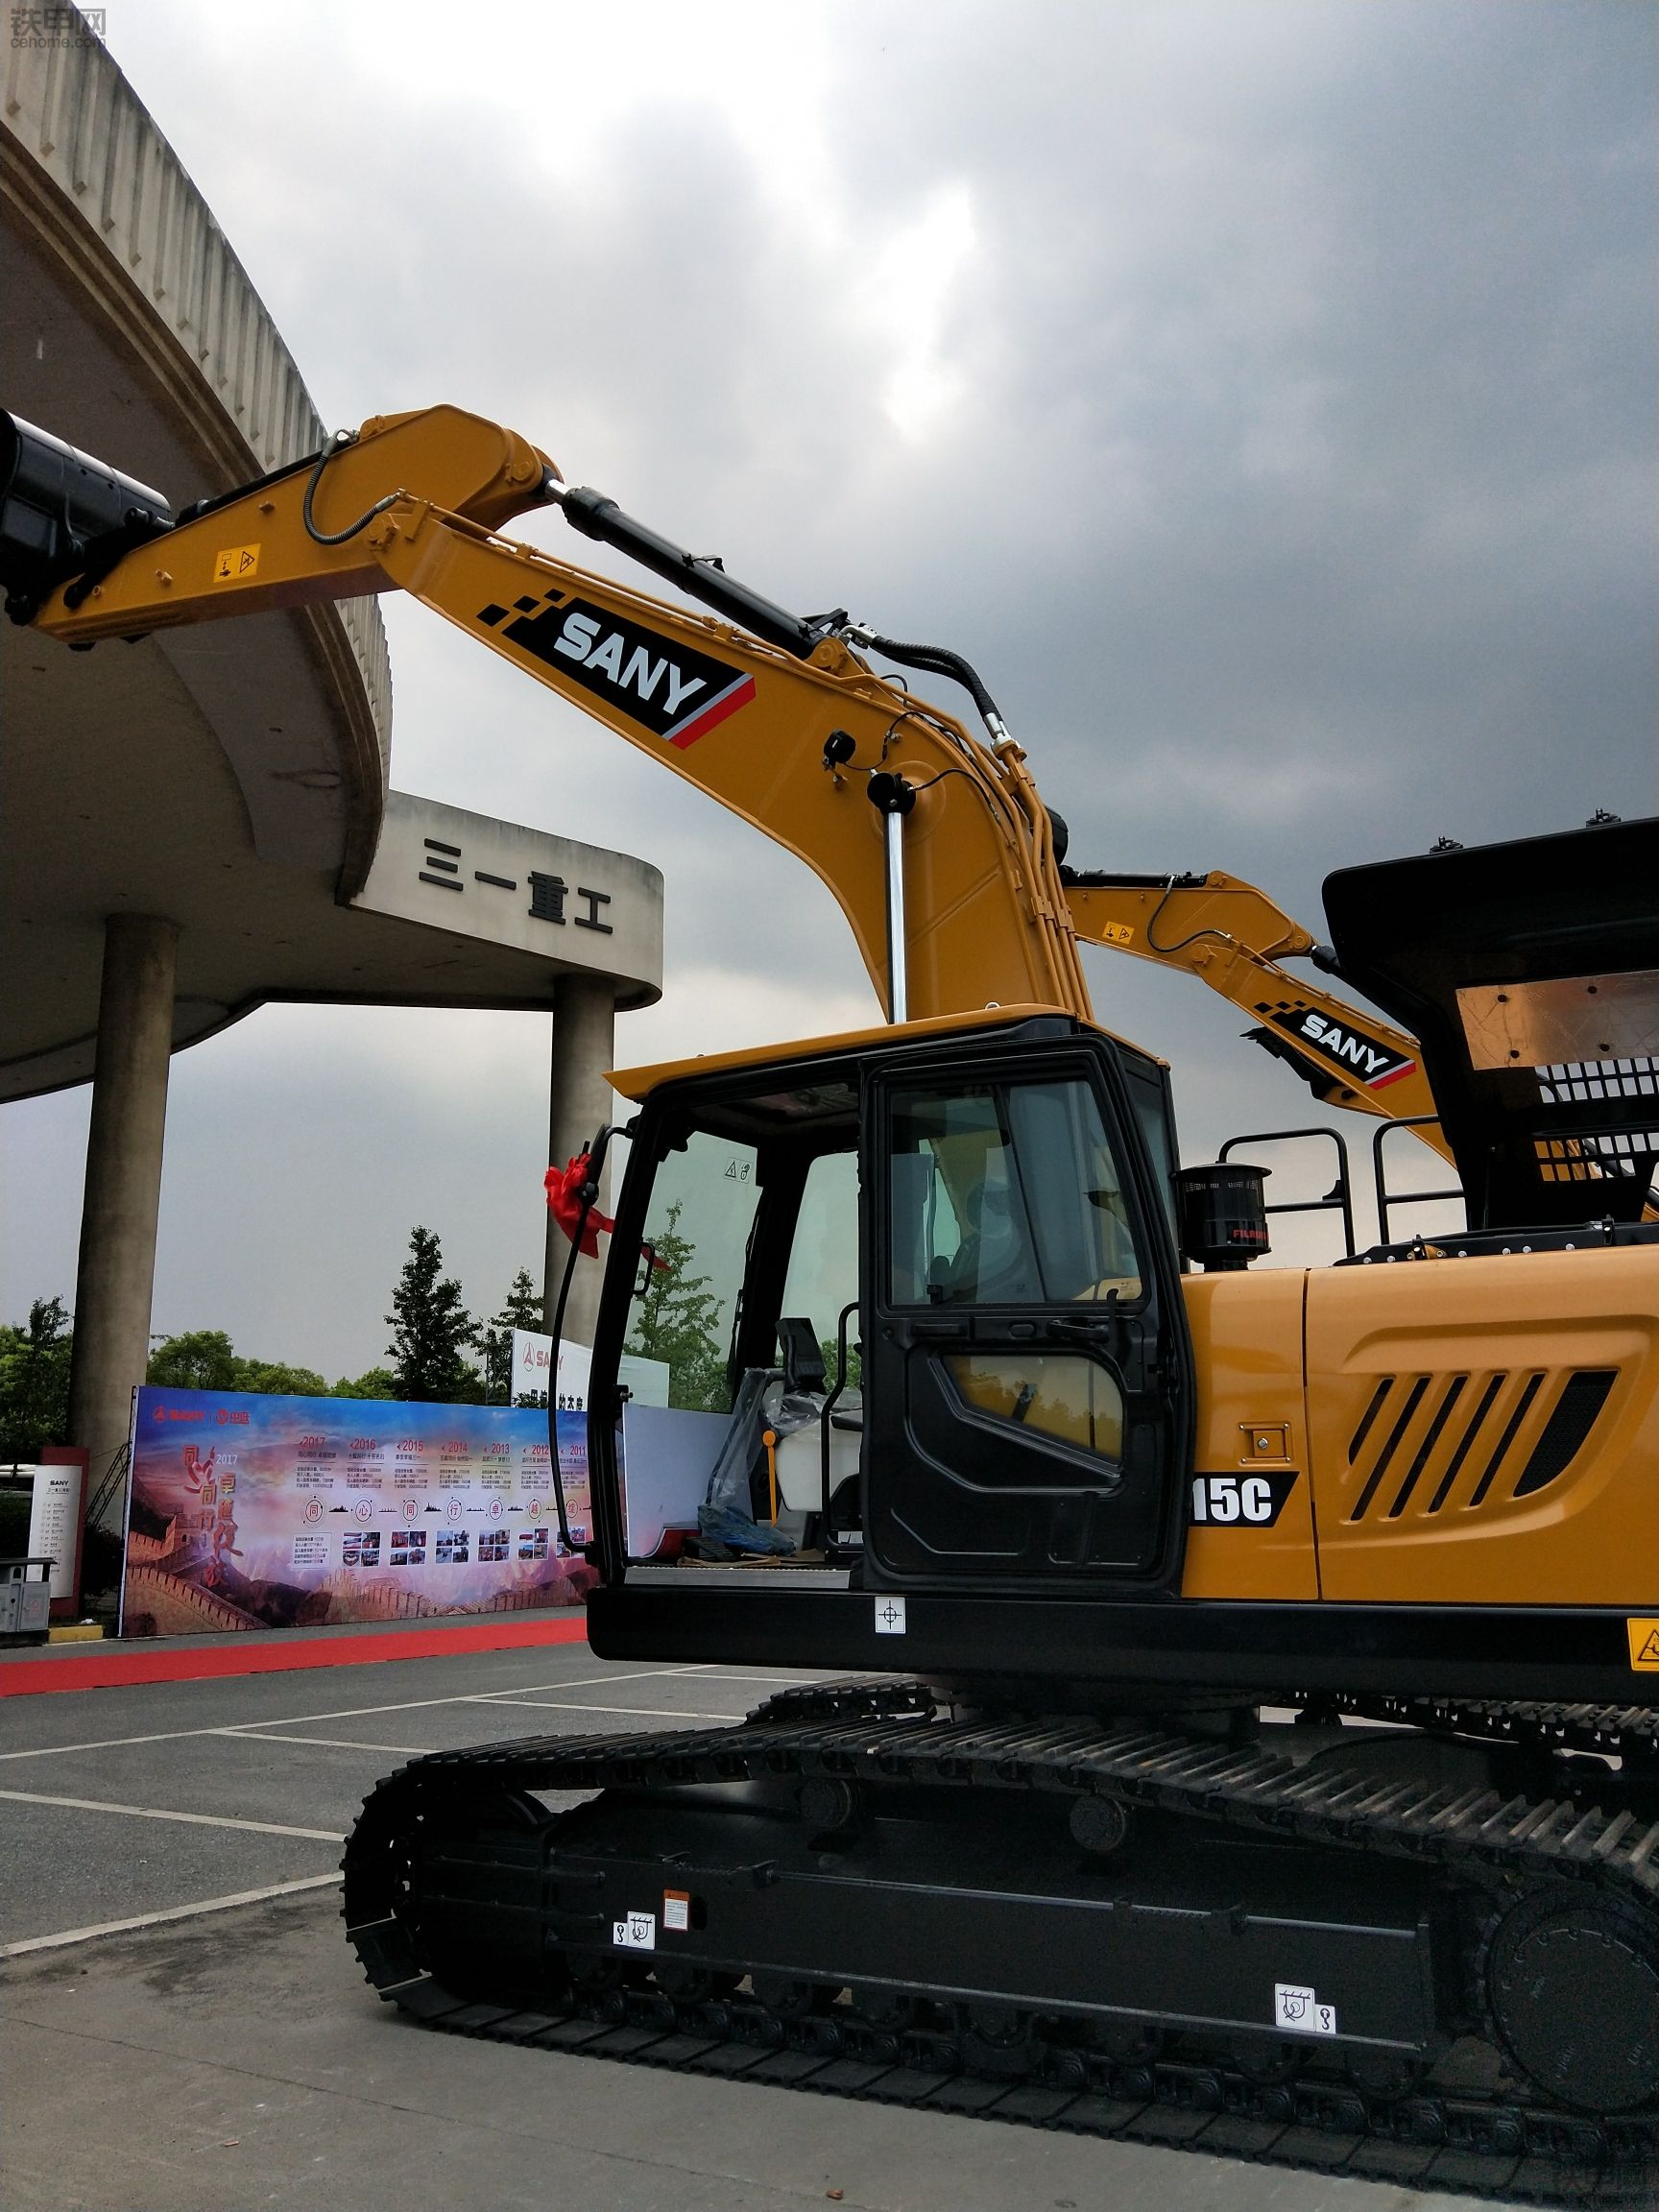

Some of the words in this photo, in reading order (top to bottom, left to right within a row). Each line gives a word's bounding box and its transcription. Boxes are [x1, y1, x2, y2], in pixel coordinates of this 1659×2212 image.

[554, 613, 707, 714] SANY
[420, 838, 613, 934] 三一重工
[1301, 1014, 1389, 1073] SANY
[537, 1351, 564, 1370] SAY
[302, 1436, 325, 1449] 2017
[353, 1438, 376, 1450] 2016
[402, 1440, 423, 1451] 2015
[448, 1441, 469, 1453] 2014
[492, 1443, 510, 1454] 2013
[532, 1444, 549, 1455] 2012
[570, 1445, 586, 1455] 2011
[216, 1455, 238, 1465] 2017
[1192, 1479, 1272, 1522] 15C
[309, 1504, 319, 1517] 同
[359, 1504, 369, 1516] 心
[406, 1503, 415, 1516] 同
[449, 1504, 459, 1516] 行
[492, 1503, 500, 1515] 卓
